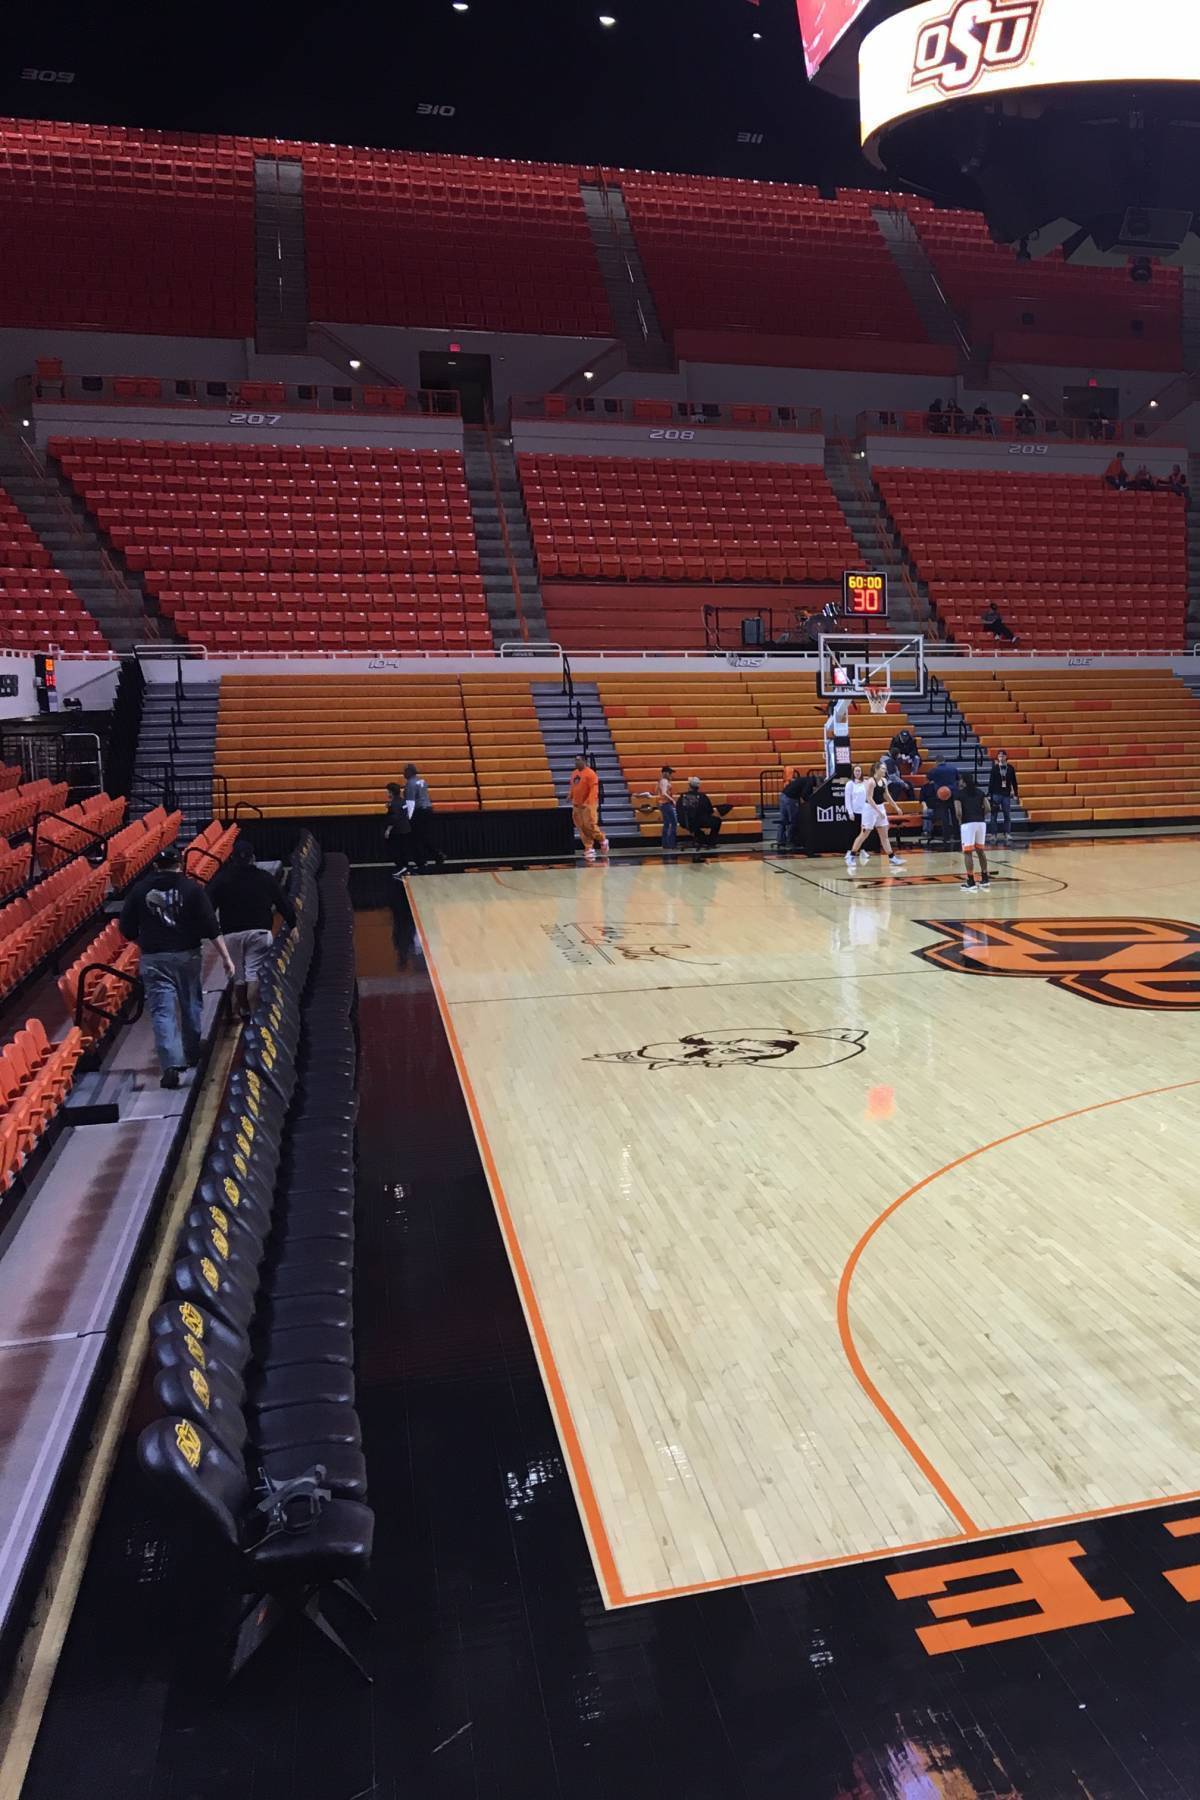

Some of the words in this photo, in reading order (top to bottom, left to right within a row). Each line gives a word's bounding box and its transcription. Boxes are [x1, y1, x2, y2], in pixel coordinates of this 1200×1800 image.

[908, 0, 1043, 96] OSU
[21, 68, 75, 83] 309
[416, 103, 455, 116] 310
[737, 132, 763, 144] 311
[229, 412, 281, 425] 207
[649, 429, 695, 440] 208
[1009, 444, 1048, 455] 209
[848, 576, 882, 589] 60:00
[853, 588, 879, 612] 30
